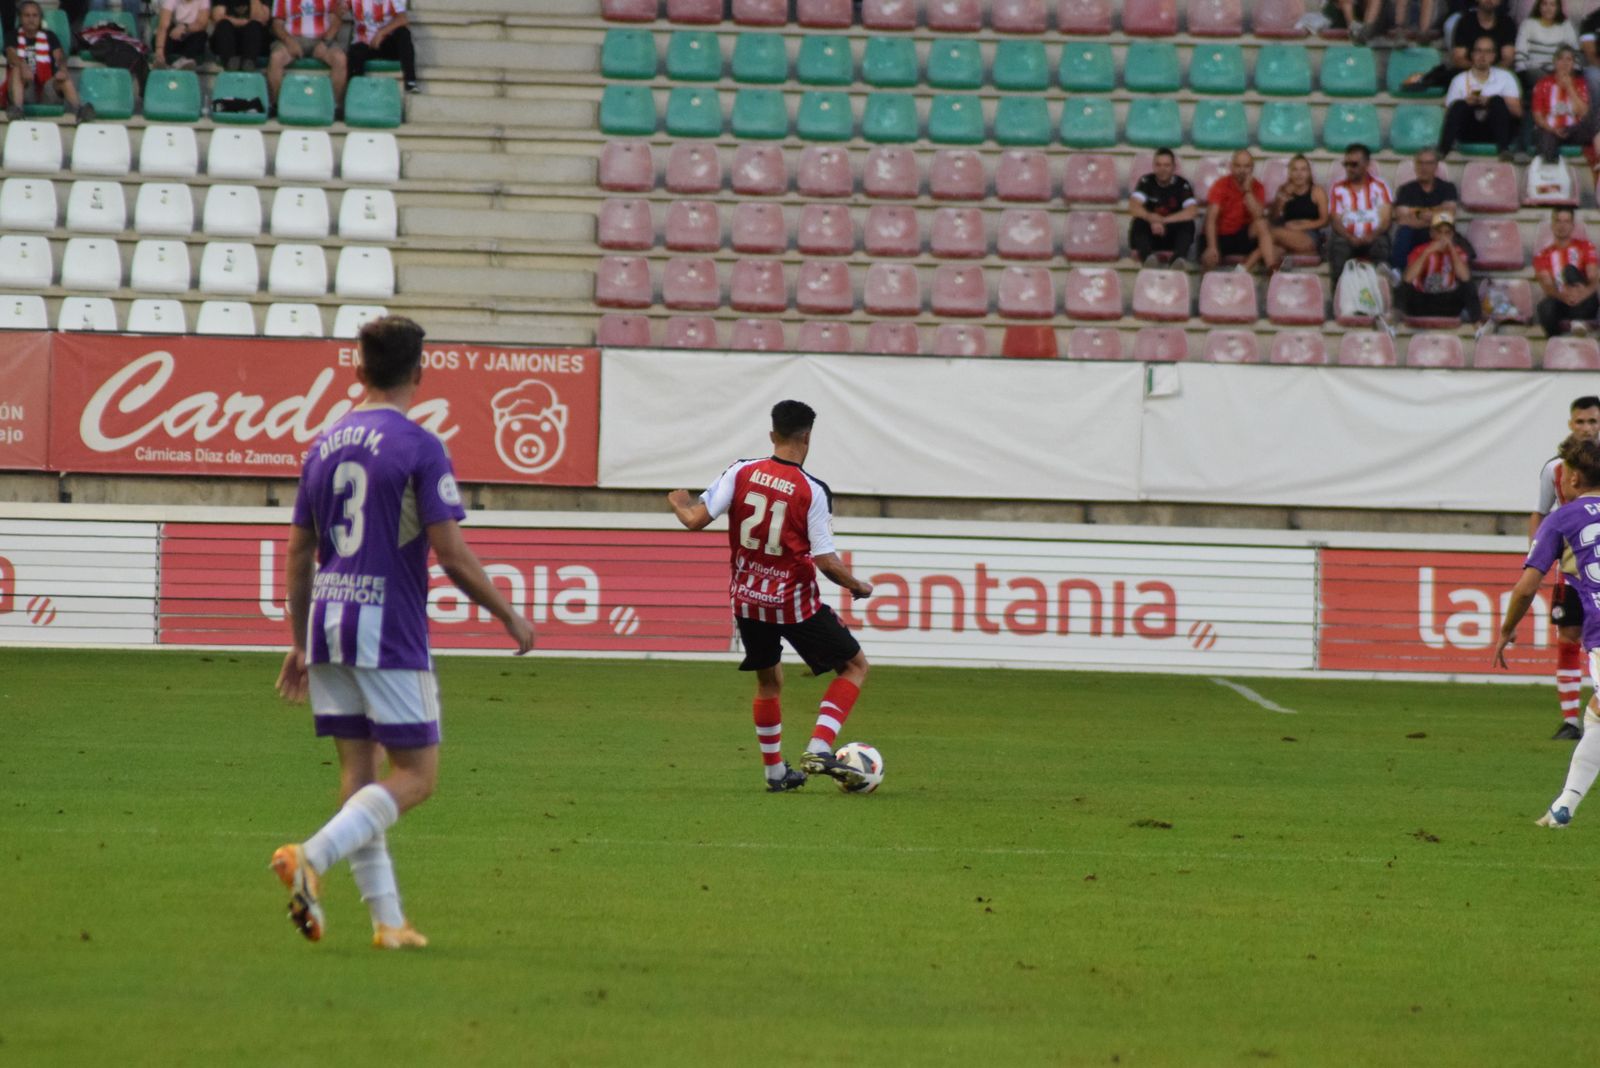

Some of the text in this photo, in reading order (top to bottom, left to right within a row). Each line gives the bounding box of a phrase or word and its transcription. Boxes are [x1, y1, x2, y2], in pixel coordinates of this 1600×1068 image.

[338, 347, 584, 373] EMDOS Y JAMONES
[79, 350, 461, 453] Cardia
[135, 446, 192, 462] Cárnicas
[195, 448, 223, 463] Díaz
[226, 450, 241, 464] de
[244, 450, 297, 467] Zamora,
[320, 426, 384, 460] DIEGO M.
[770, 477, 797, 496] ARES
[330, 462, 368, 558] 3
[740, 491, 787, 557] 21
[748, 561, 790, 579] Villafuel
[311, 587, 384, 605] UTRITION
[839, 551, 1177, 640] lantania
[1419, 567, 1549, 650] lan
